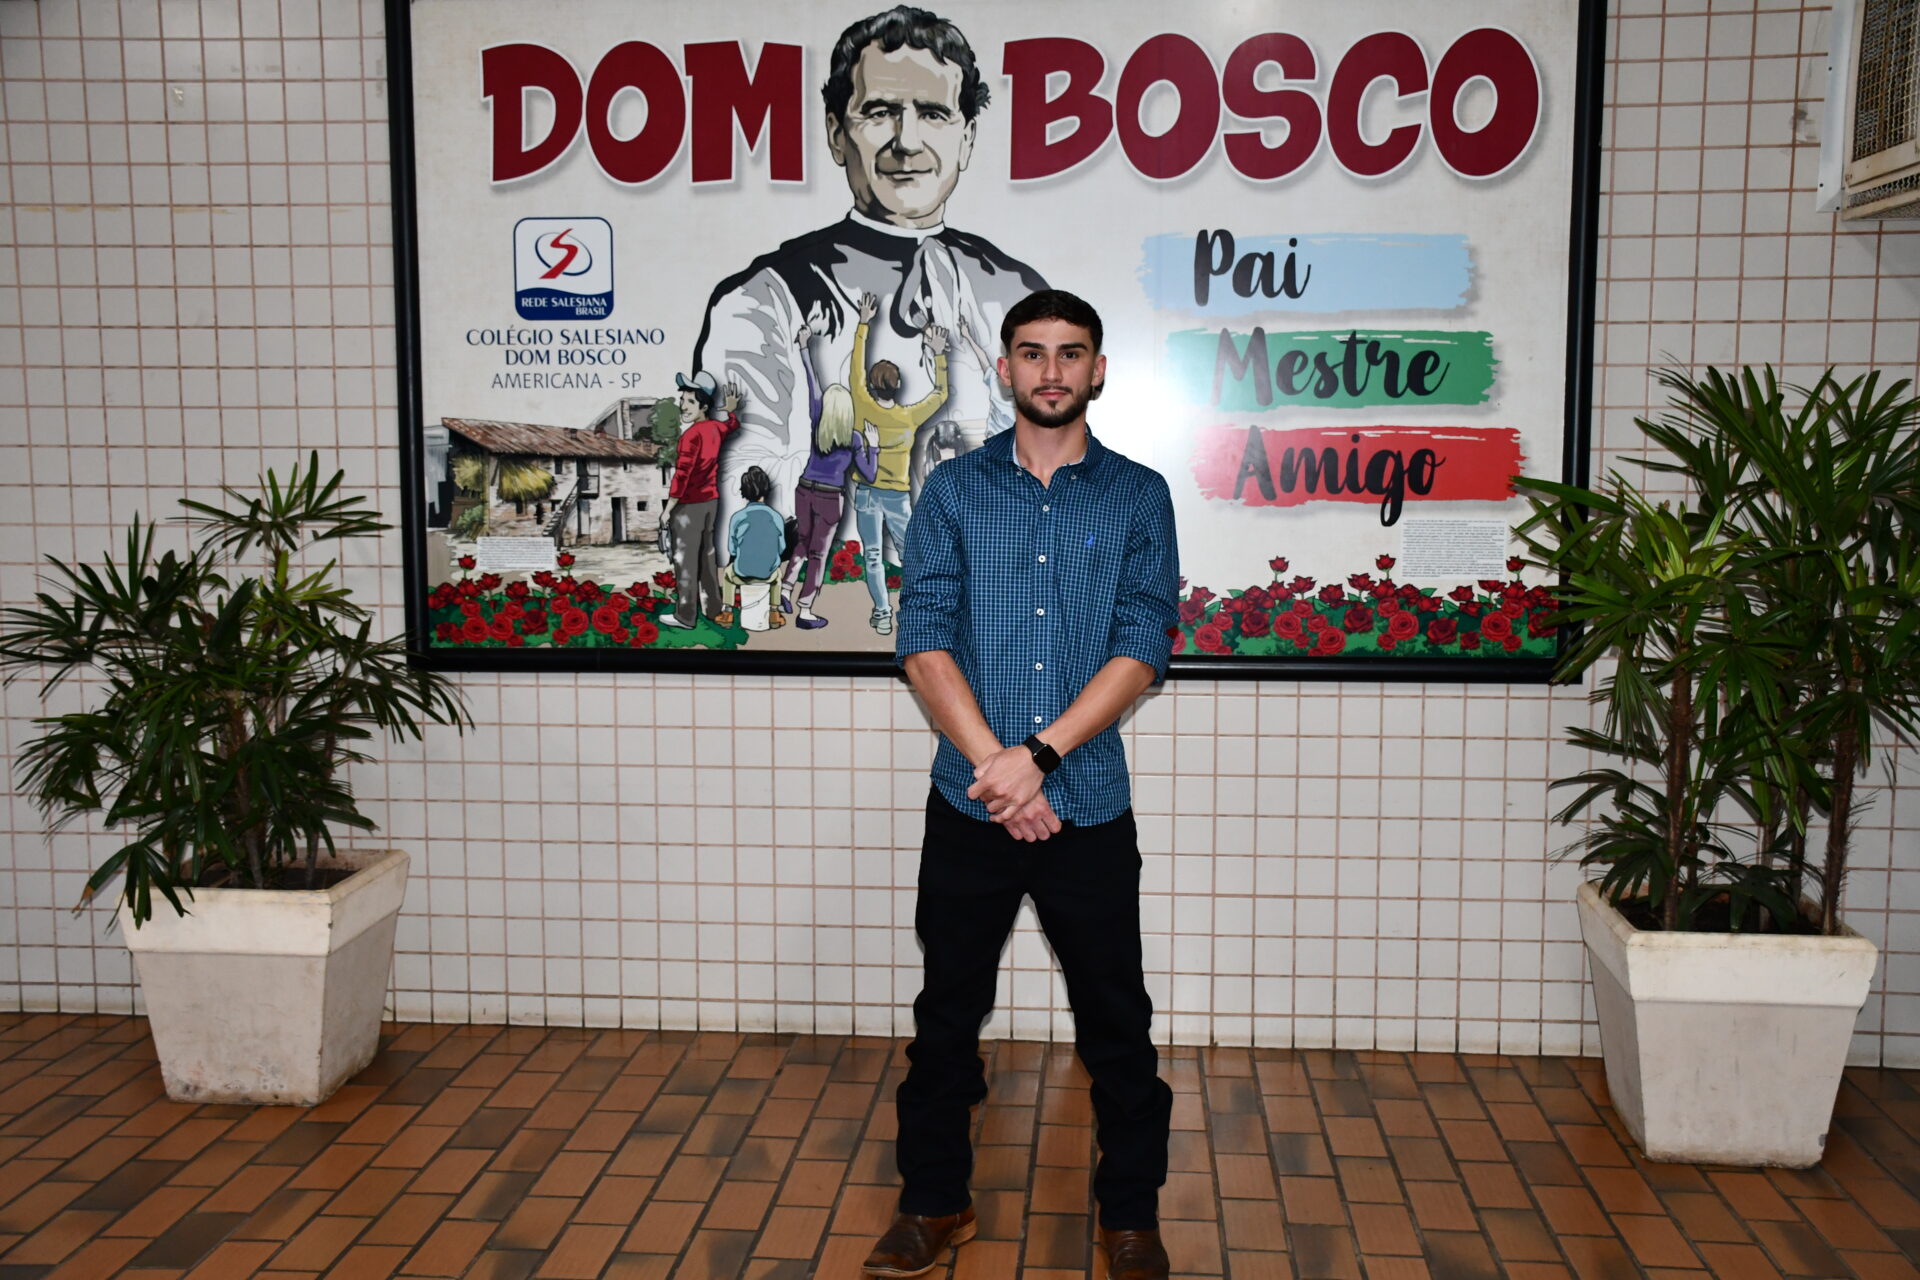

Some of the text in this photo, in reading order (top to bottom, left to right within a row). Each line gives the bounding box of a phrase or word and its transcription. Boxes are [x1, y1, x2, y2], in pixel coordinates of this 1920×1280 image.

[482, 28, 1540, 183] DOM BOSCO
[1194, 229, 1311, 307] Pai
[521, 297, 607, 308] REDE SALESIANA
[575, 307, 607, 316] BRASIL
[466, 324, 665, 345] COLÉGIO SALESIANO
[505, 349, 626, 365] DOM BOSCO
[1211, 326, 1450, 406] Mestre
[491, 373, 602, 389] AMERICANA
[621, 373, 642, 388] SP
[1233, 425, 1447, 527] Amigo
